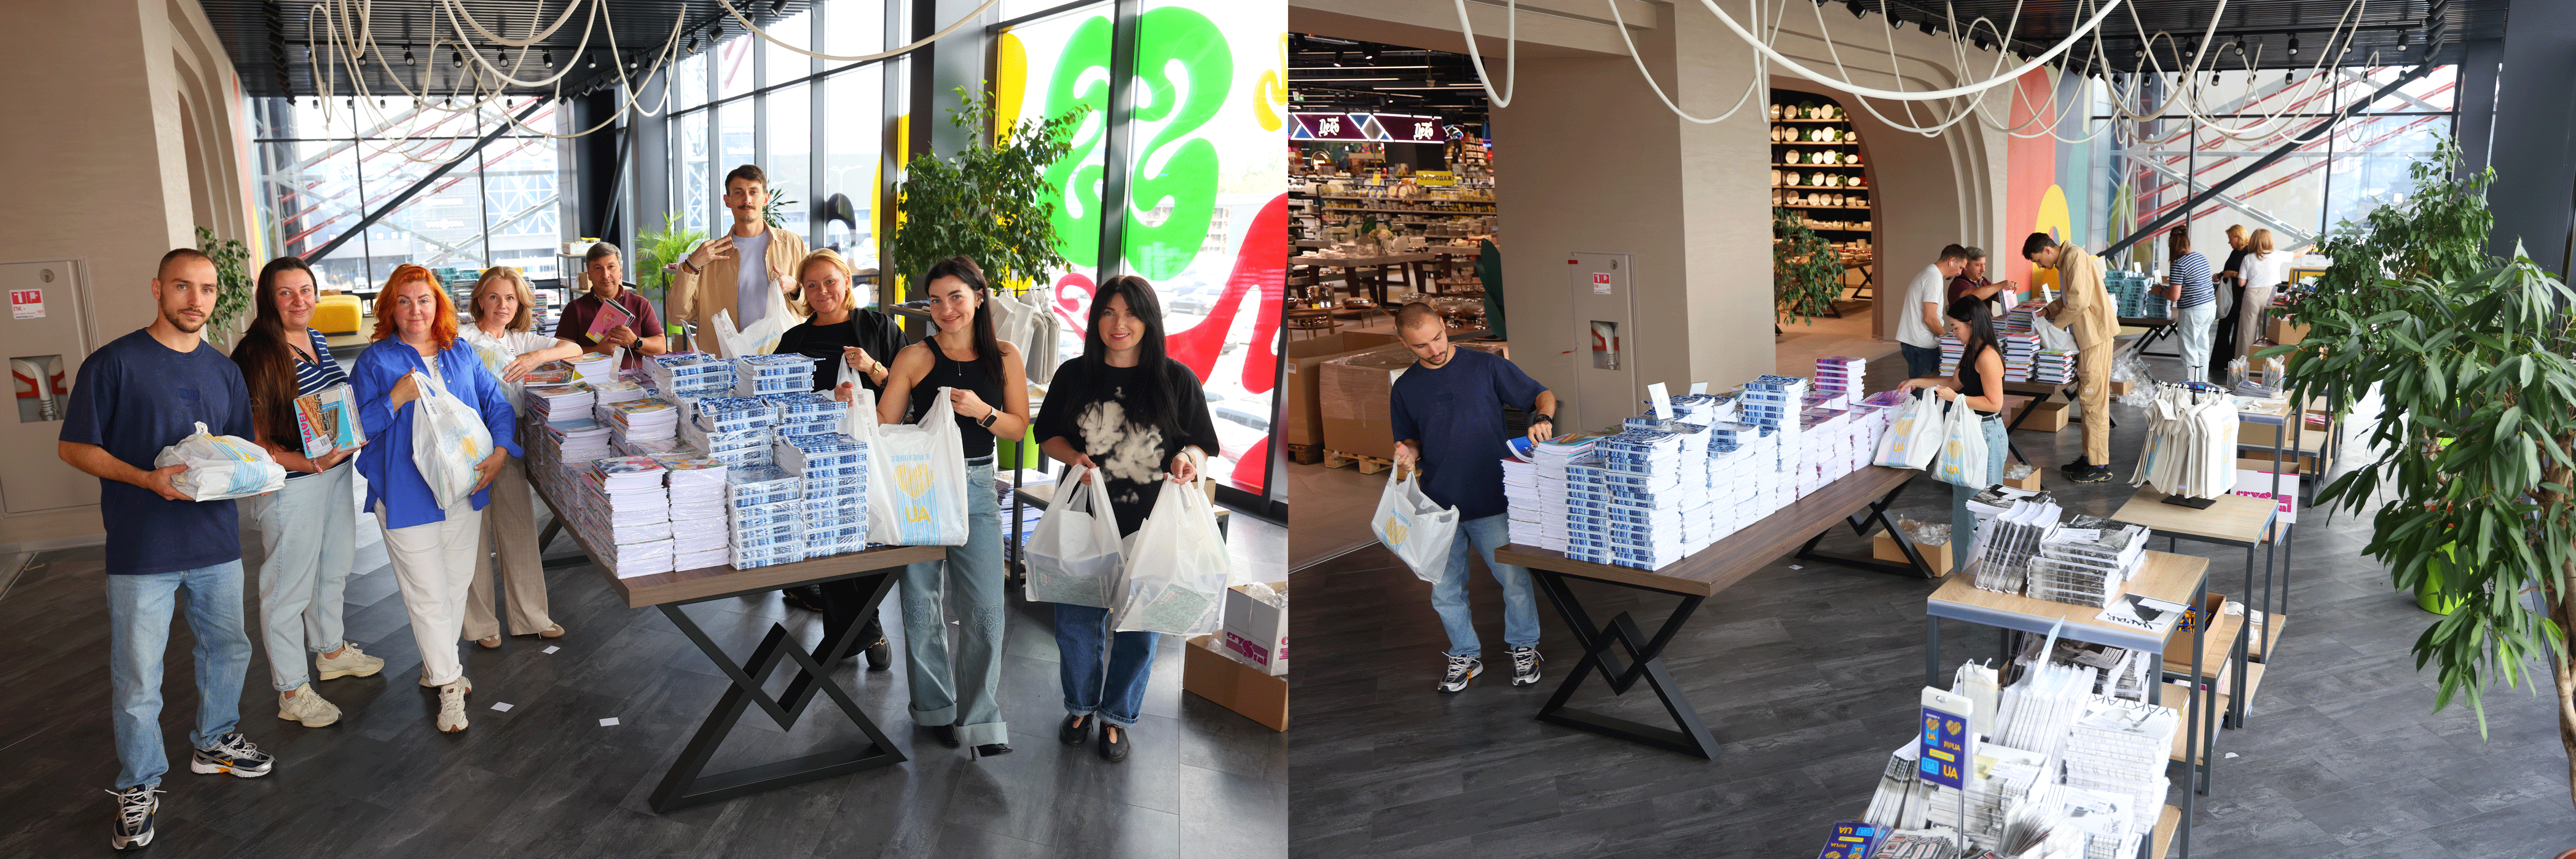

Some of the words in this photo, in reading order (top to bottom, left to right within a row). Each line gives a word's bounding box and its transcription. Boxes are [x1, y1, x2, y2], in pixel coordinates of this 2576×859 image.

[1893, 442, 1904, 452] UA
[1946, 463, 1960, 474] UA
[905, 505, 932, 523] UA
[1943, 764, 1958, 780] UA
